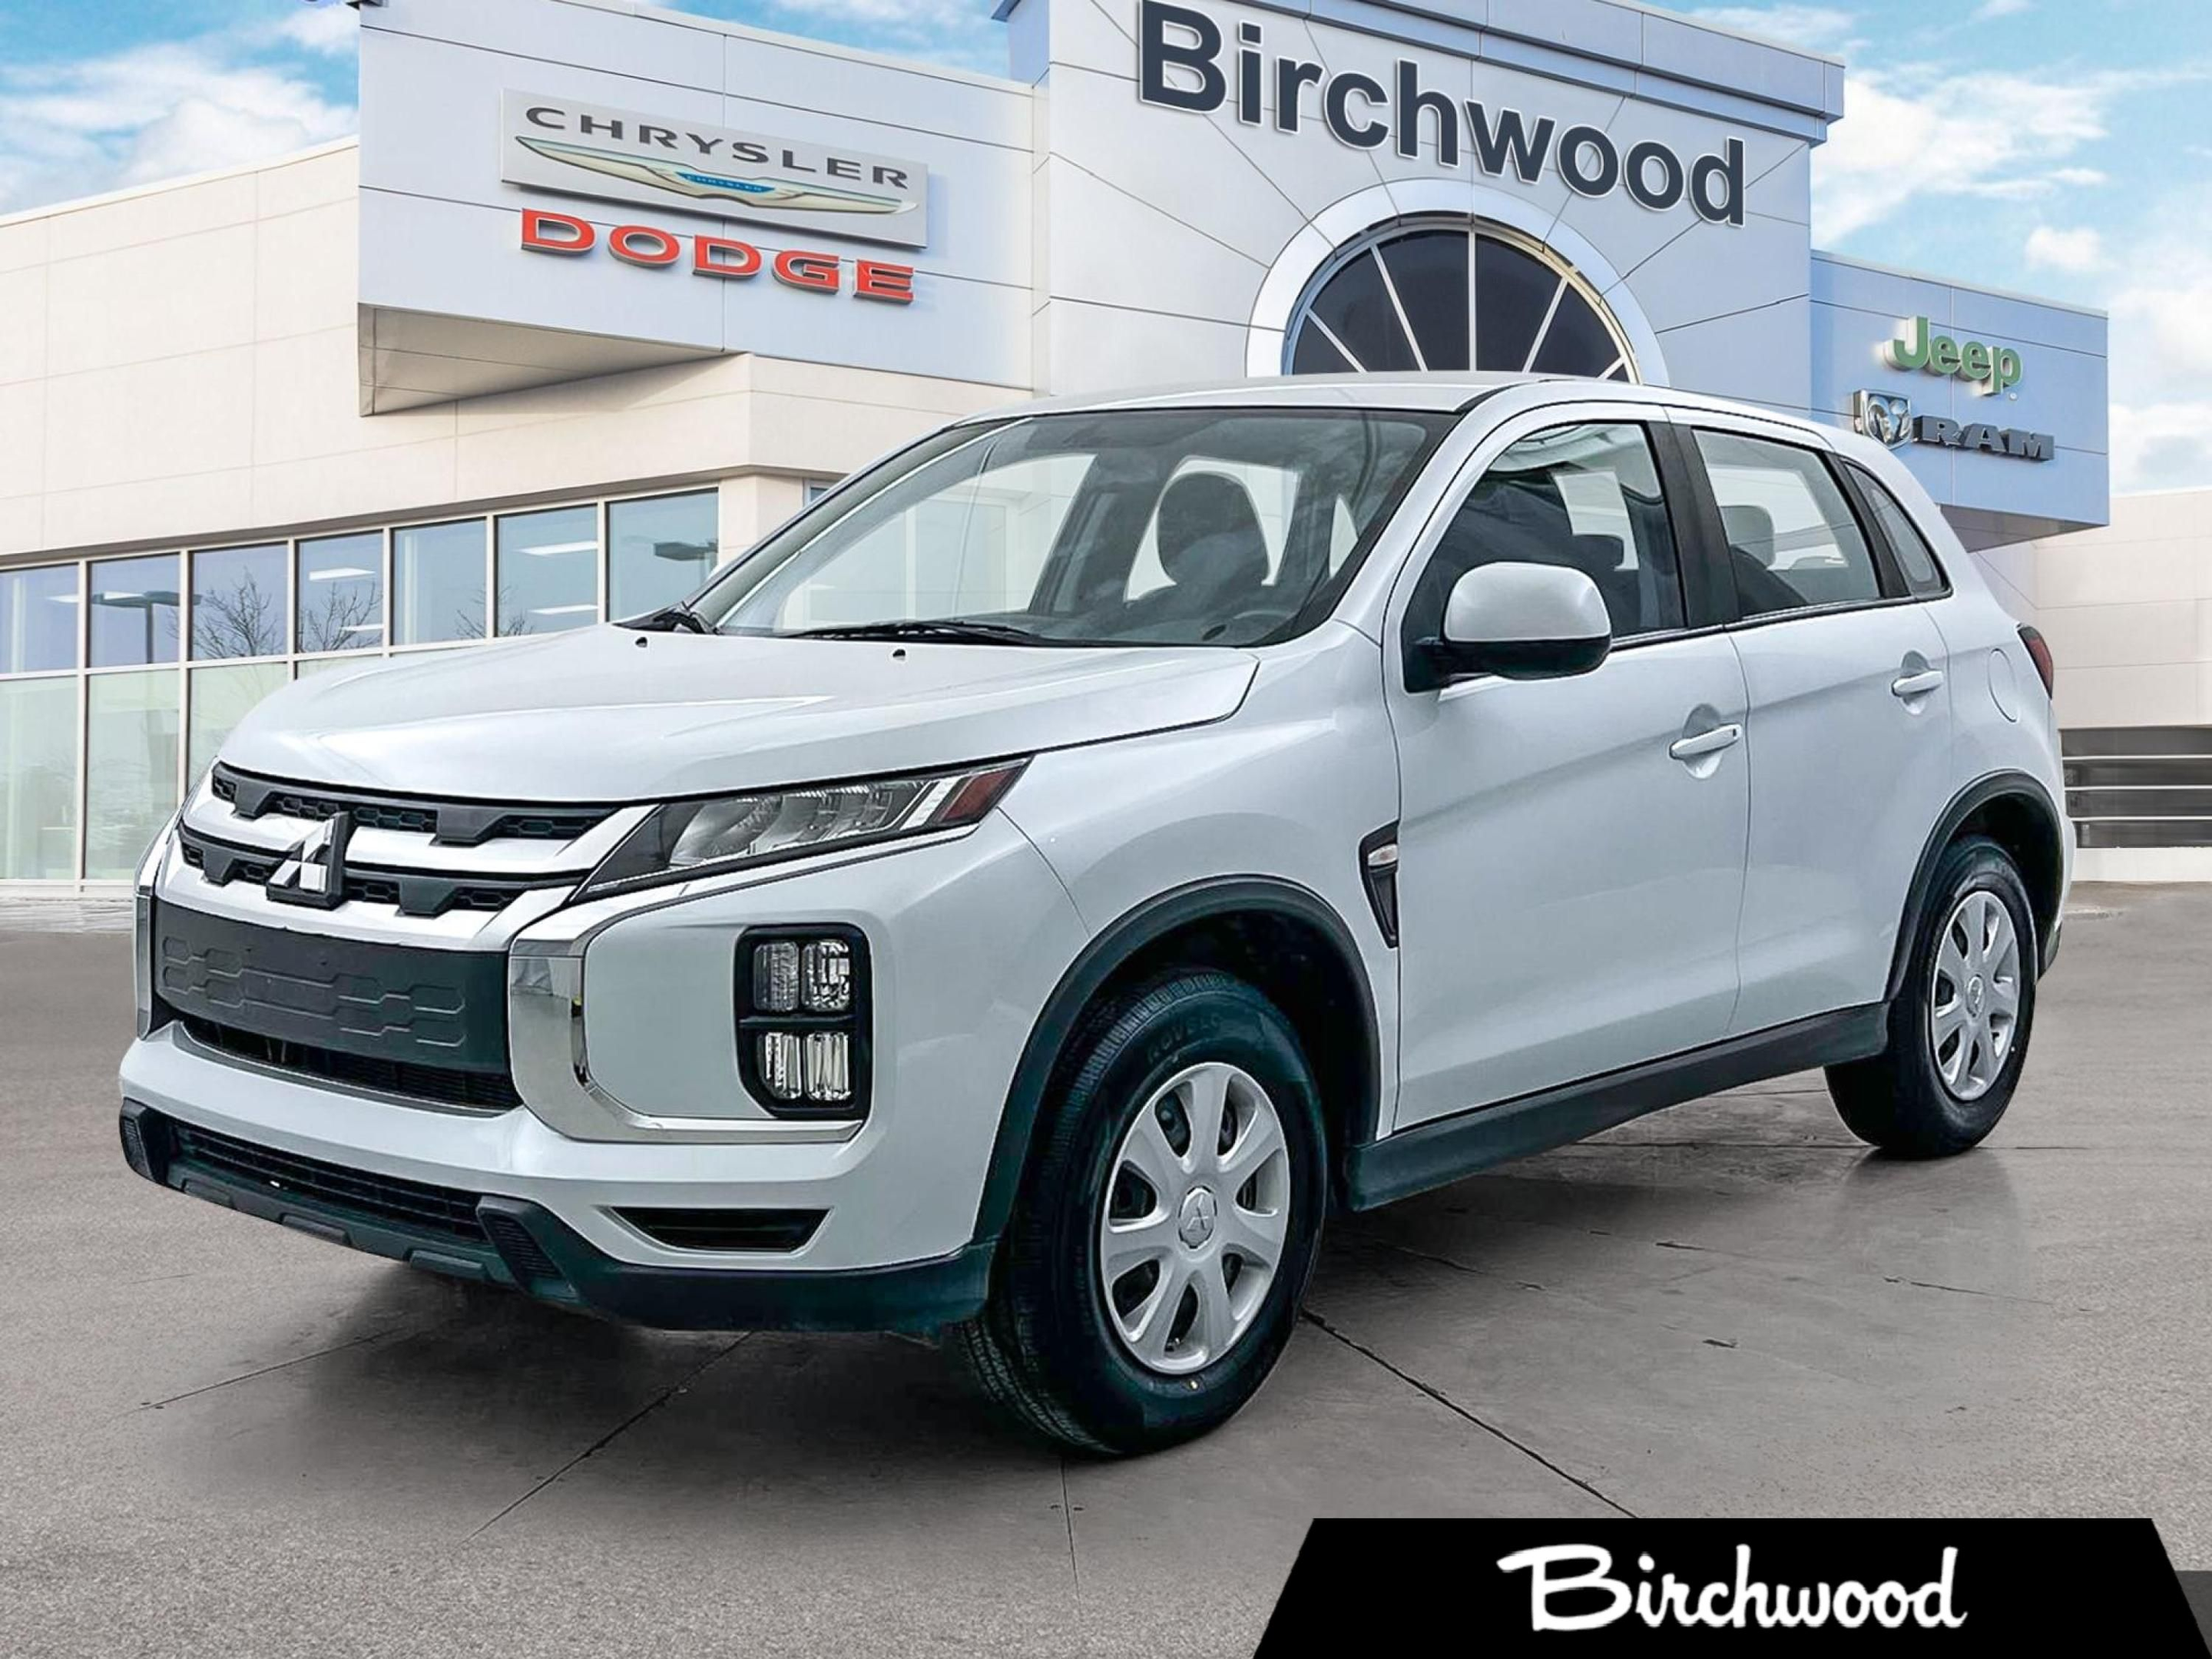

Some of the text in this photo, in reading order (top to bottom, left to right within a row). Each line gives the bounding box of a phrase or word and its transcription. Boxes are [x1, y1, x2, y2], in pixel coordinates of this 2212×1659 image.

[526, 106, 909, 190] CHRYSLER
[1140, 0, 1745, 227] Birchwood
[521, 207, 915, 304] DODGE
[1884, 315, 2023, 396] Jeep
[1912, 415, 2055, 462] RAM
